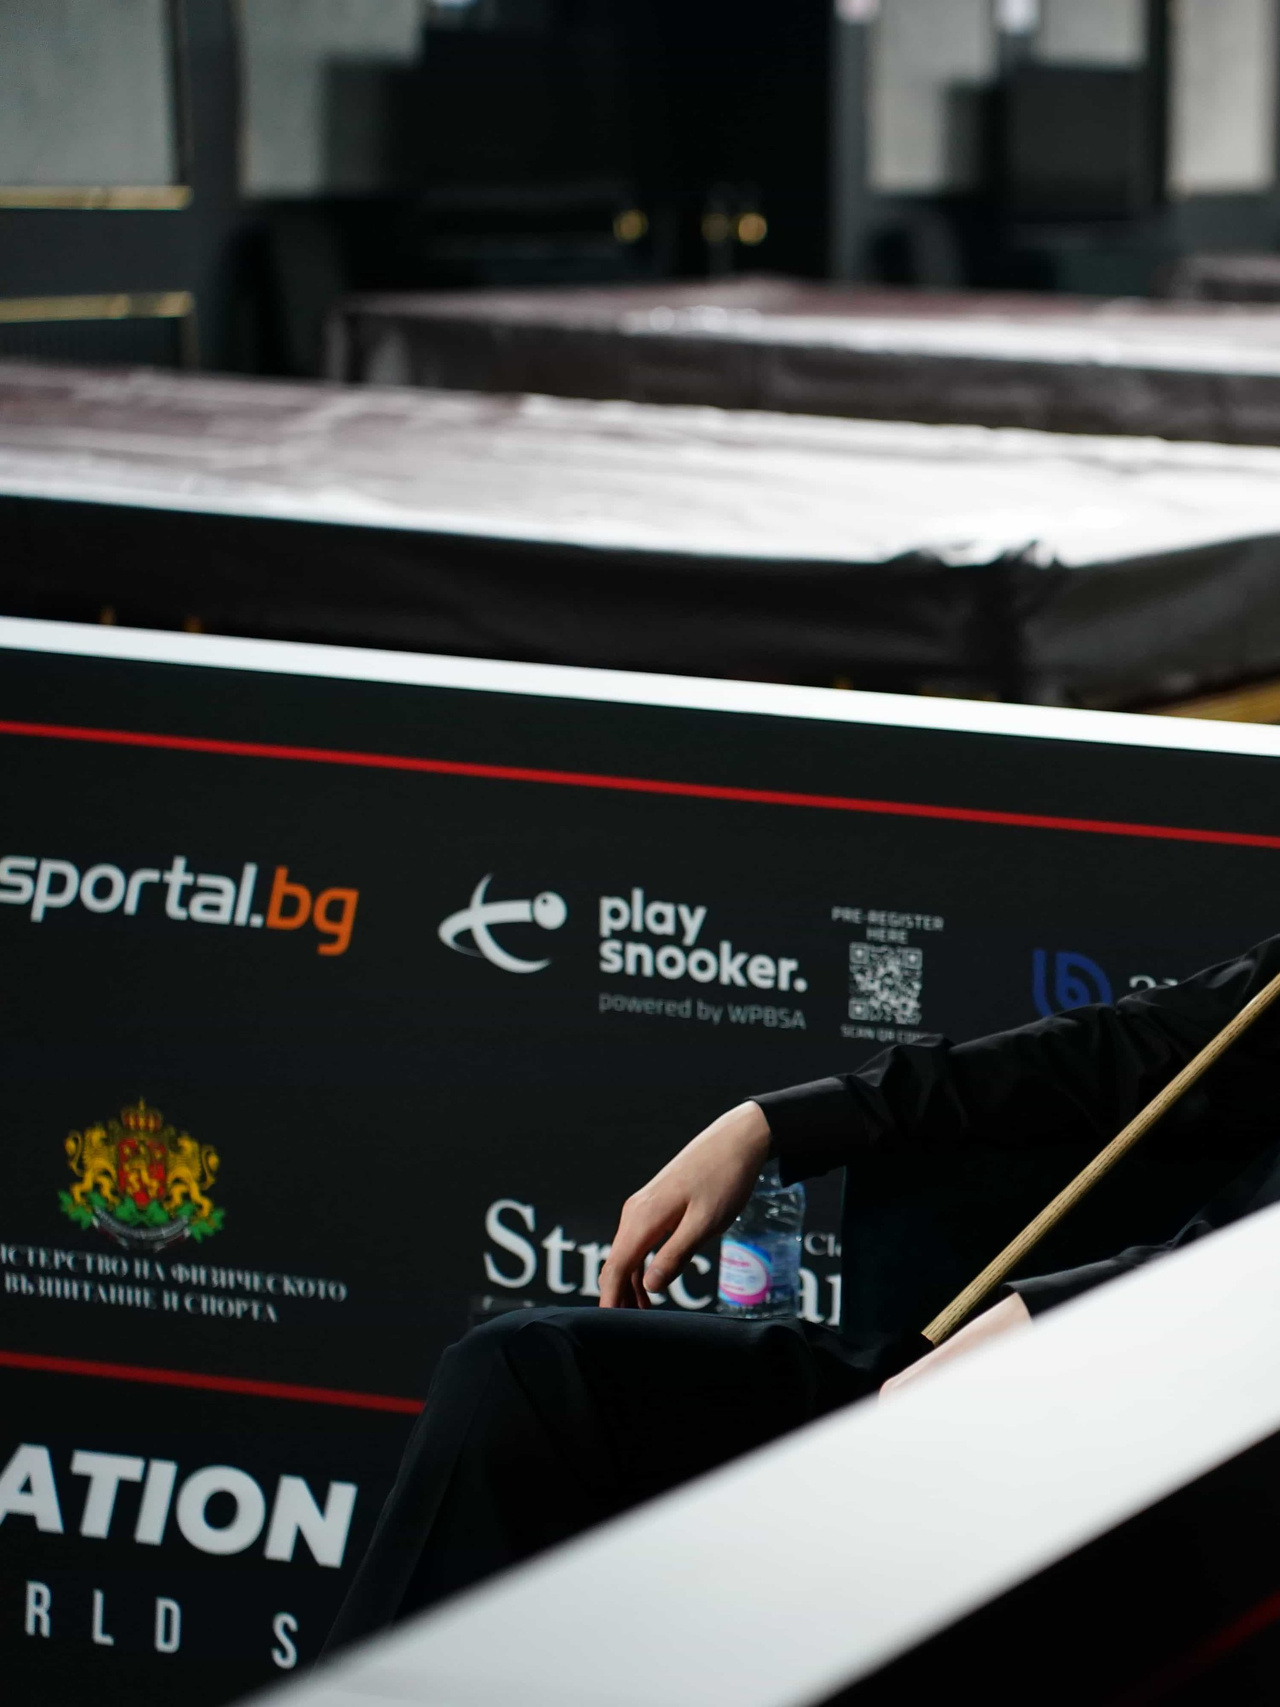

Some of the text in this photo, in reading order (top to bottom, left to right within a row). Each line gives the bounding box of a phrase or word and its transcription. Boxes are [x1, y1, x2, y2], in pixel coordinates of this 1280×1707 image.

[0, 855, 359, 956] sportal.bg
[600, 887, 707, 946] play
[866, 926, 908, 944] HERE
[600, 940, 808, 993] snooker.
[599, 993, 807, 1030] powered by WPBSA
[184, 1291, 279, 1323] СПОРТА
[0, 1443, 357, 1569] ATION
